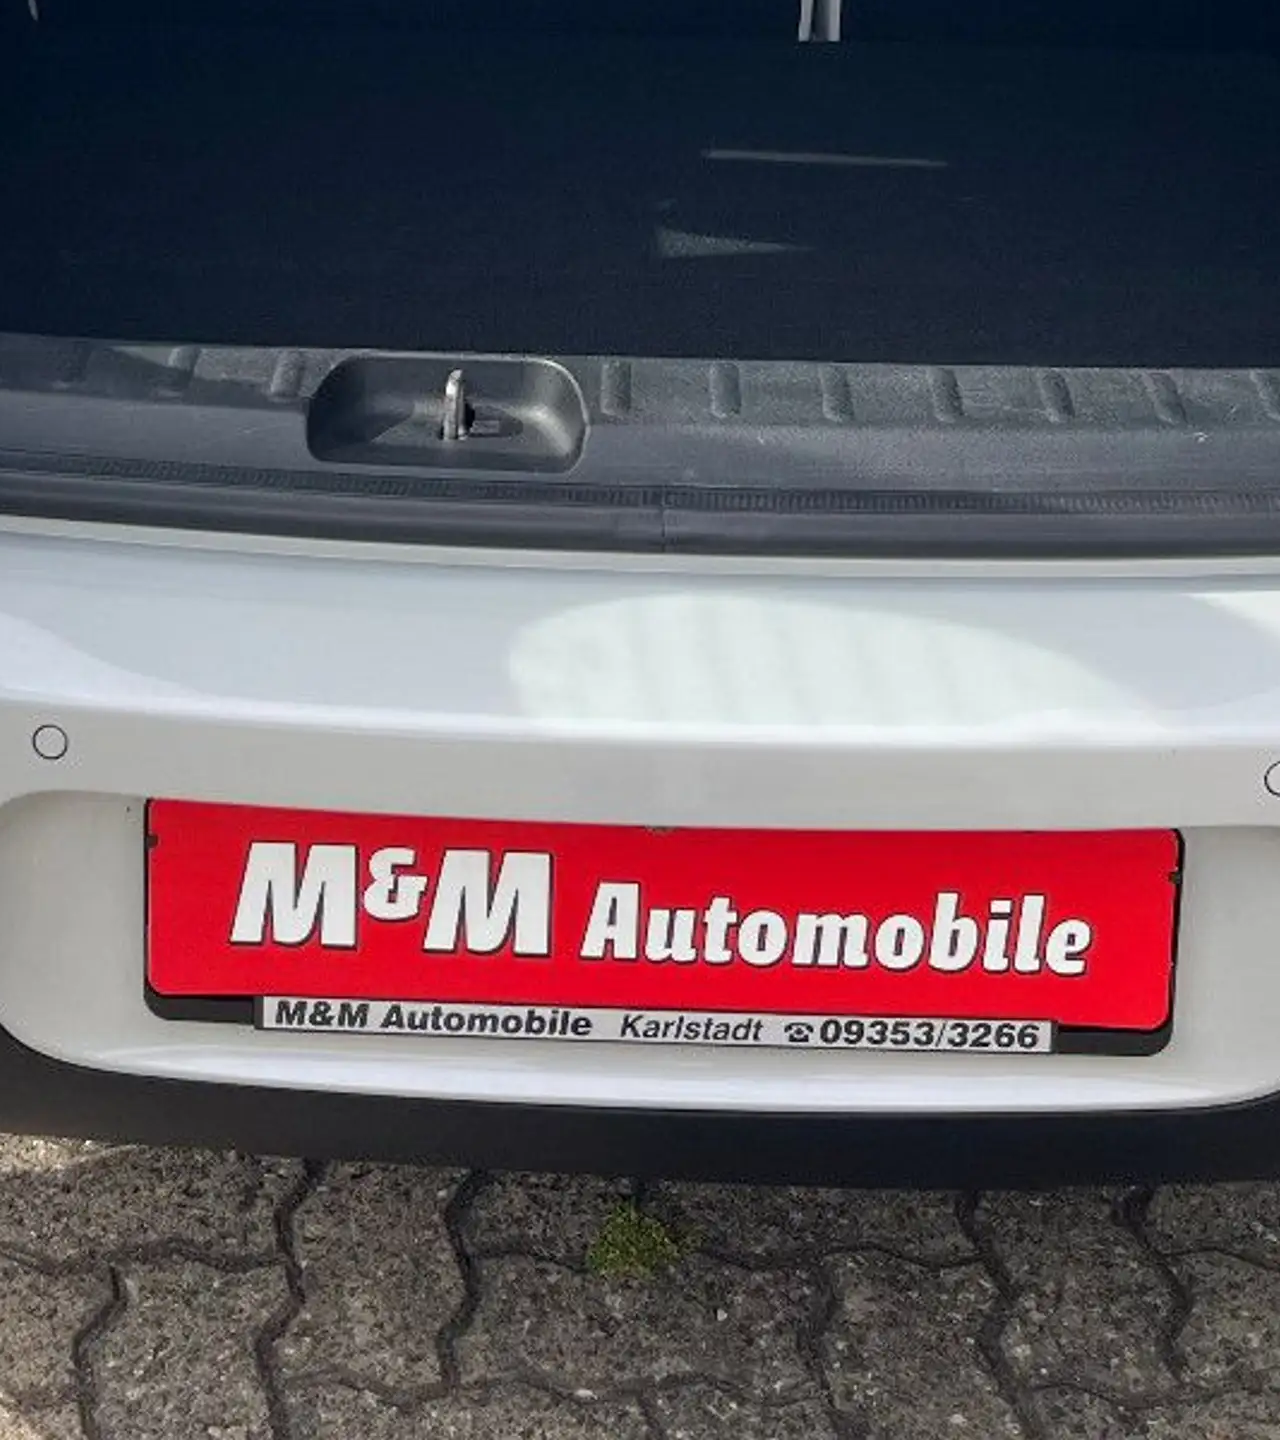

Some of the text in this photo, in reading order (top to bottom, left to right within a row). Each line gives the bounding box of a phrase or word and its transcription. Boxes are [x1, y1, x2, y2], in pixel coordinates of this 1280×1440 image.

[228, 841, 1092, 975] M&M Automobile
[274, 1000, 1040, 1050] M&M Automobile Karlstadt 09353/3266
